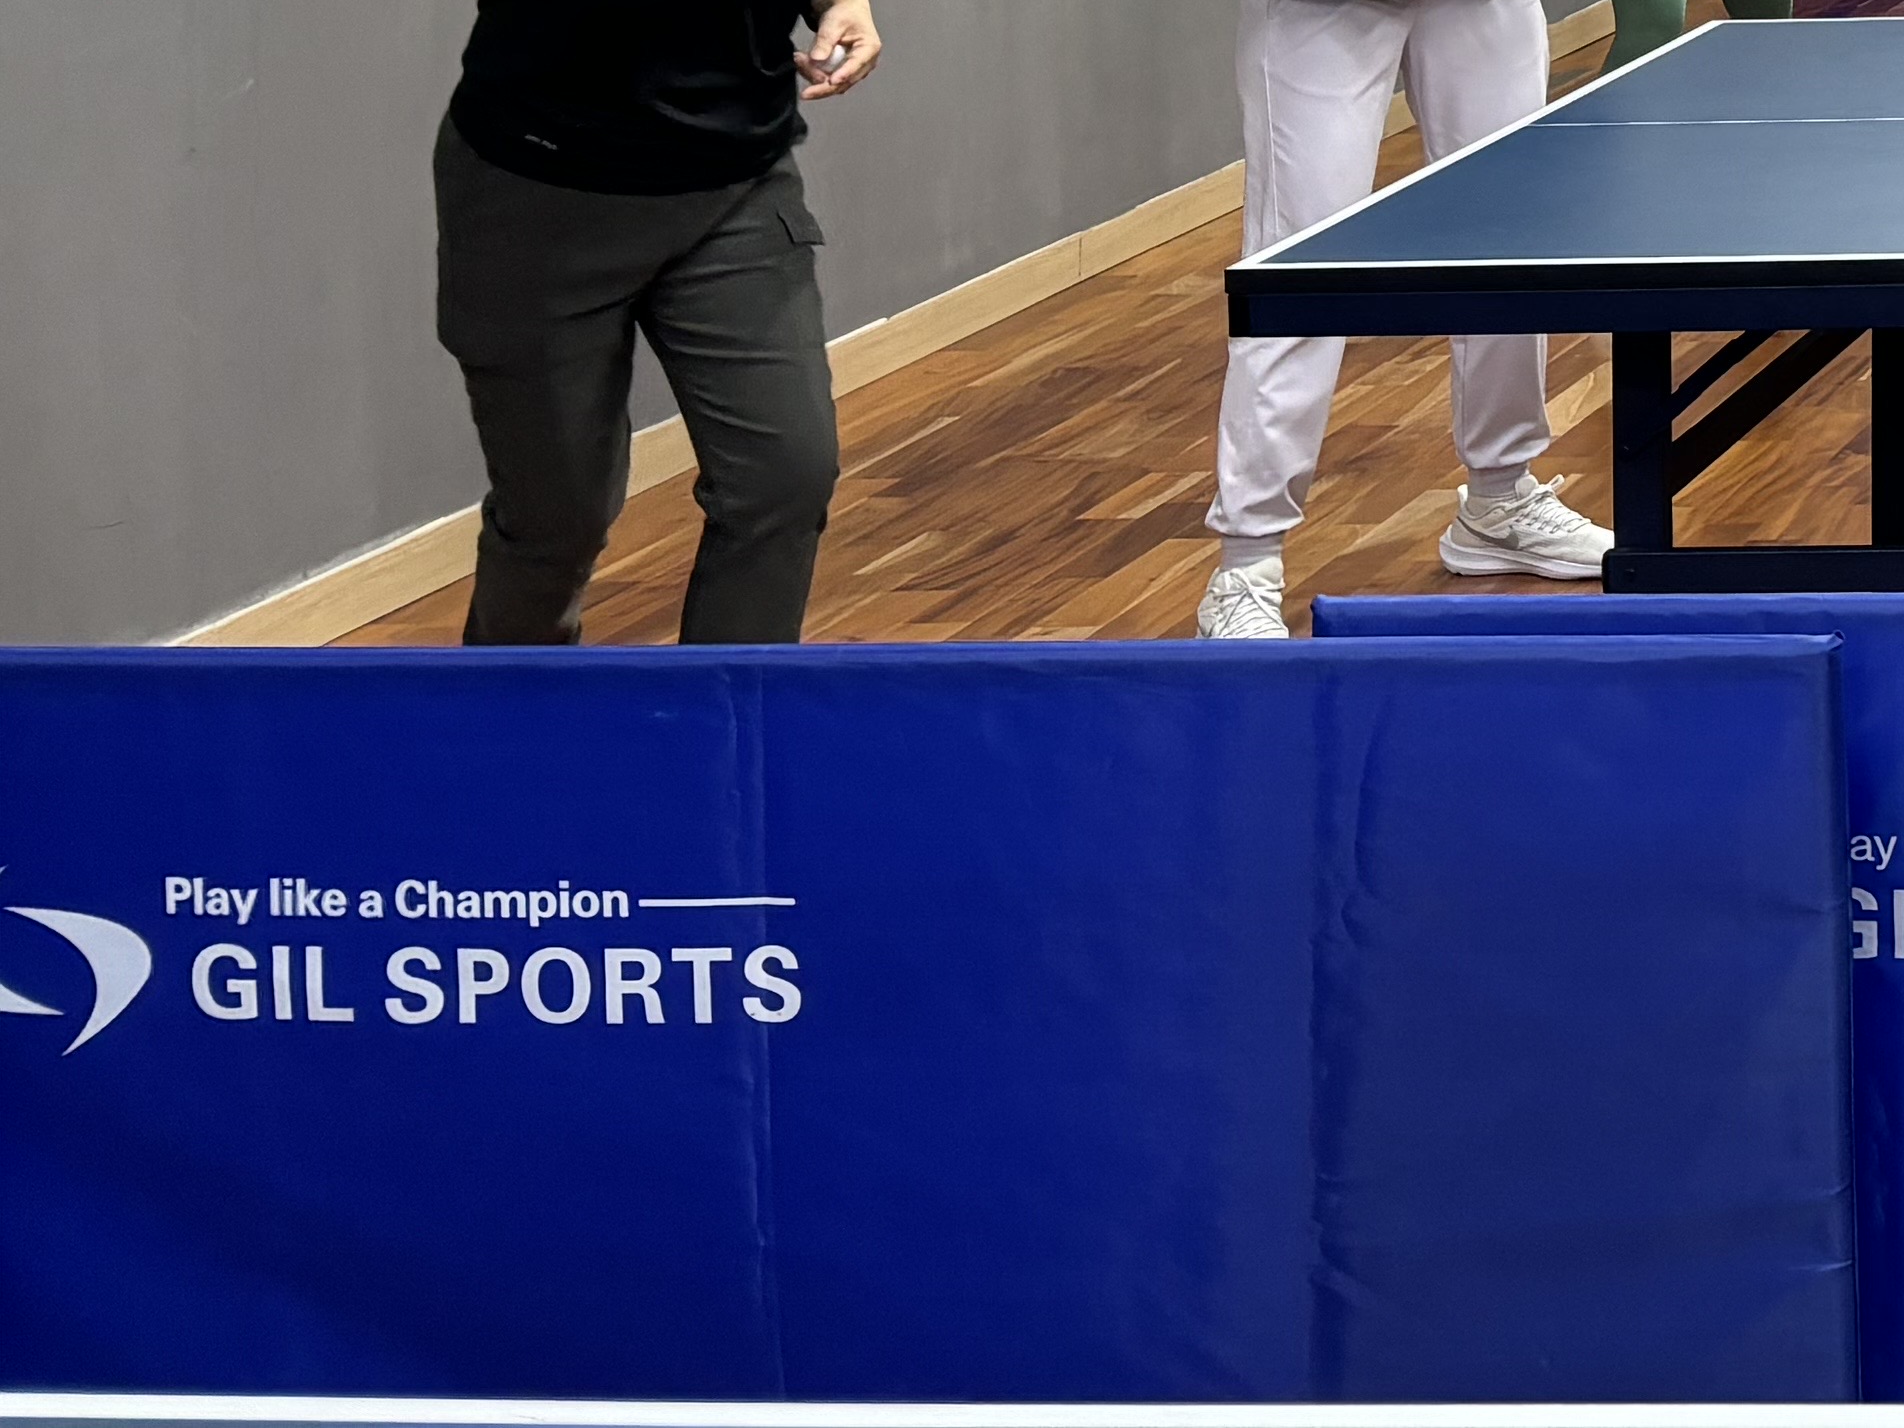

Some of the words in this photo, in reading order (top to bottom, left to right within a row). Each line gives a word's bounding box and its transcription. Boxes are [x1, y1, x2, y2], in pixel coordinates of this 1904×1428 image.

[1850, 835, 1897, 870] ay
[165, 876, 258, 925] Play
[269, 877, 347, 917] like
[358, 890, 384, 918] a
[395, 879, 630, 928] Champion
[191, 943, 355, 1022] GIL
[384, 944, 802, 1025] SPORTS
